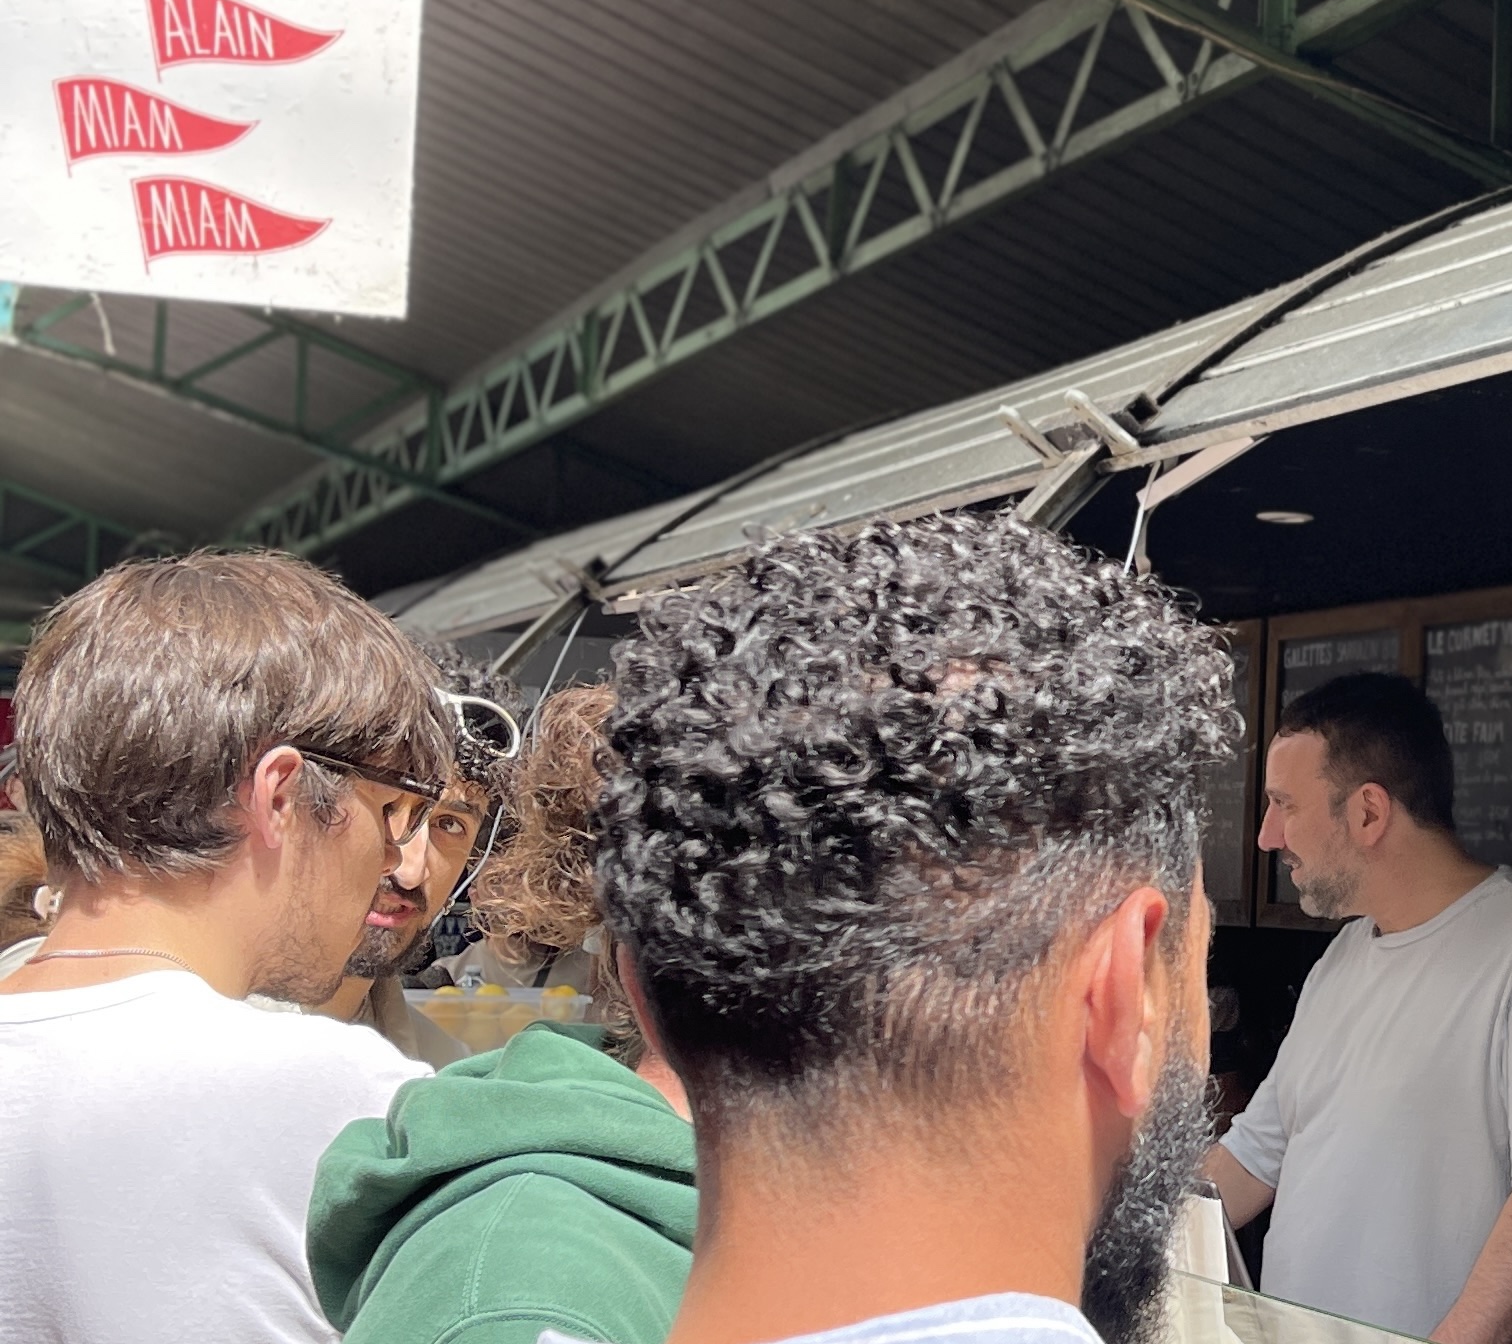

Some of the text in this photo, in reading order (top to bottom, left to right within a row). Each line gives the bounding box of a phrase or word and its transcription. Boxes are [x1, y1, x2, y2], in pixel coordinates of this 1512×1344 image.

[72, 84, 184, 153] MIAM
[149, 182, 262, 252] MIAM
[1427, 629, 1446, 656] LE
